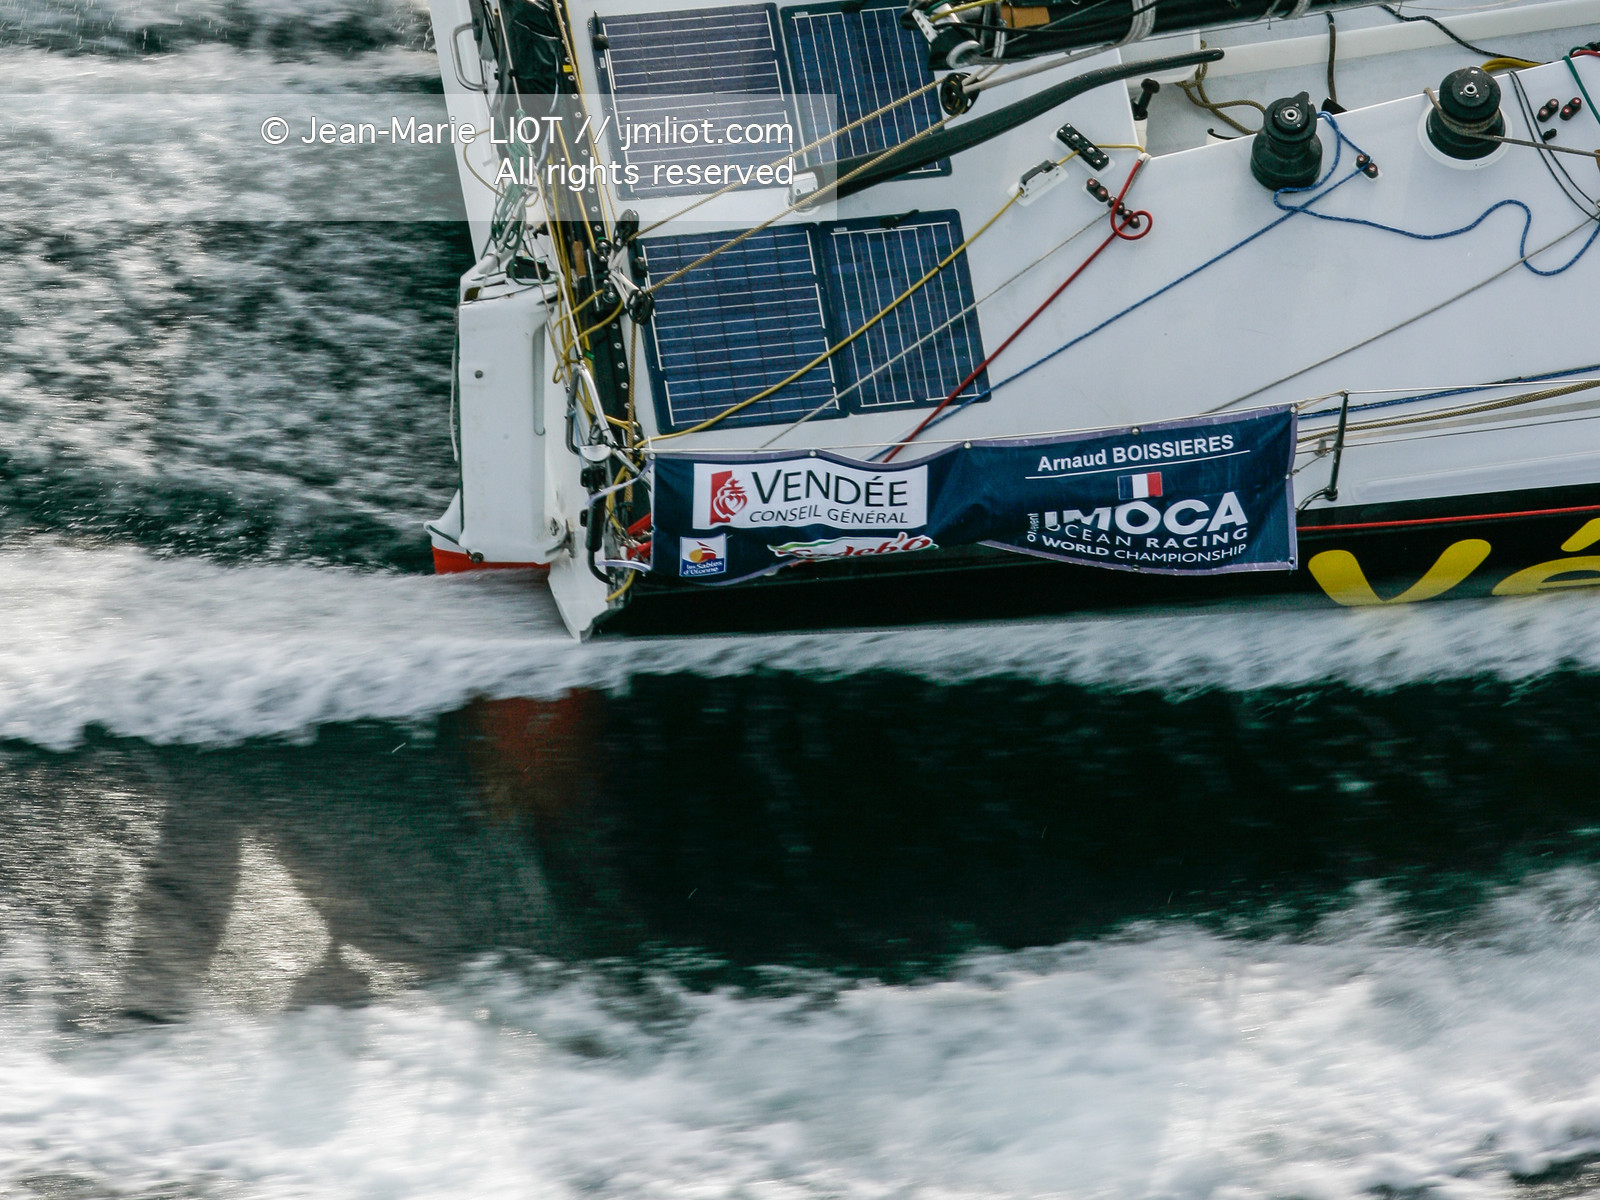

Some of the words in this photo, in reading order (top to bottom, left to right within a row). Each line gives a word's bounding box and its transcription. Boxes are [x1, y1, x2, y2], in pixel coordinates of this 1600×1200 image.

[1037, 448, 1107, 473] Arnaud
[1112, 434, 1235, 463] BOISSIERES
[751, 468, 908, 508] VENDÉE
[749, 504, 822, 524] CONSEIL
[827, 509, 909, 524] GÉNÉRAL
[1044, 491, 1249, 536] IMOCA
[1041, 534, 1110, 556] WORLD
[1113, 543, 1247, 563] CHAMPIONSHIP
[1145, 527, 1248, 550] RACING
